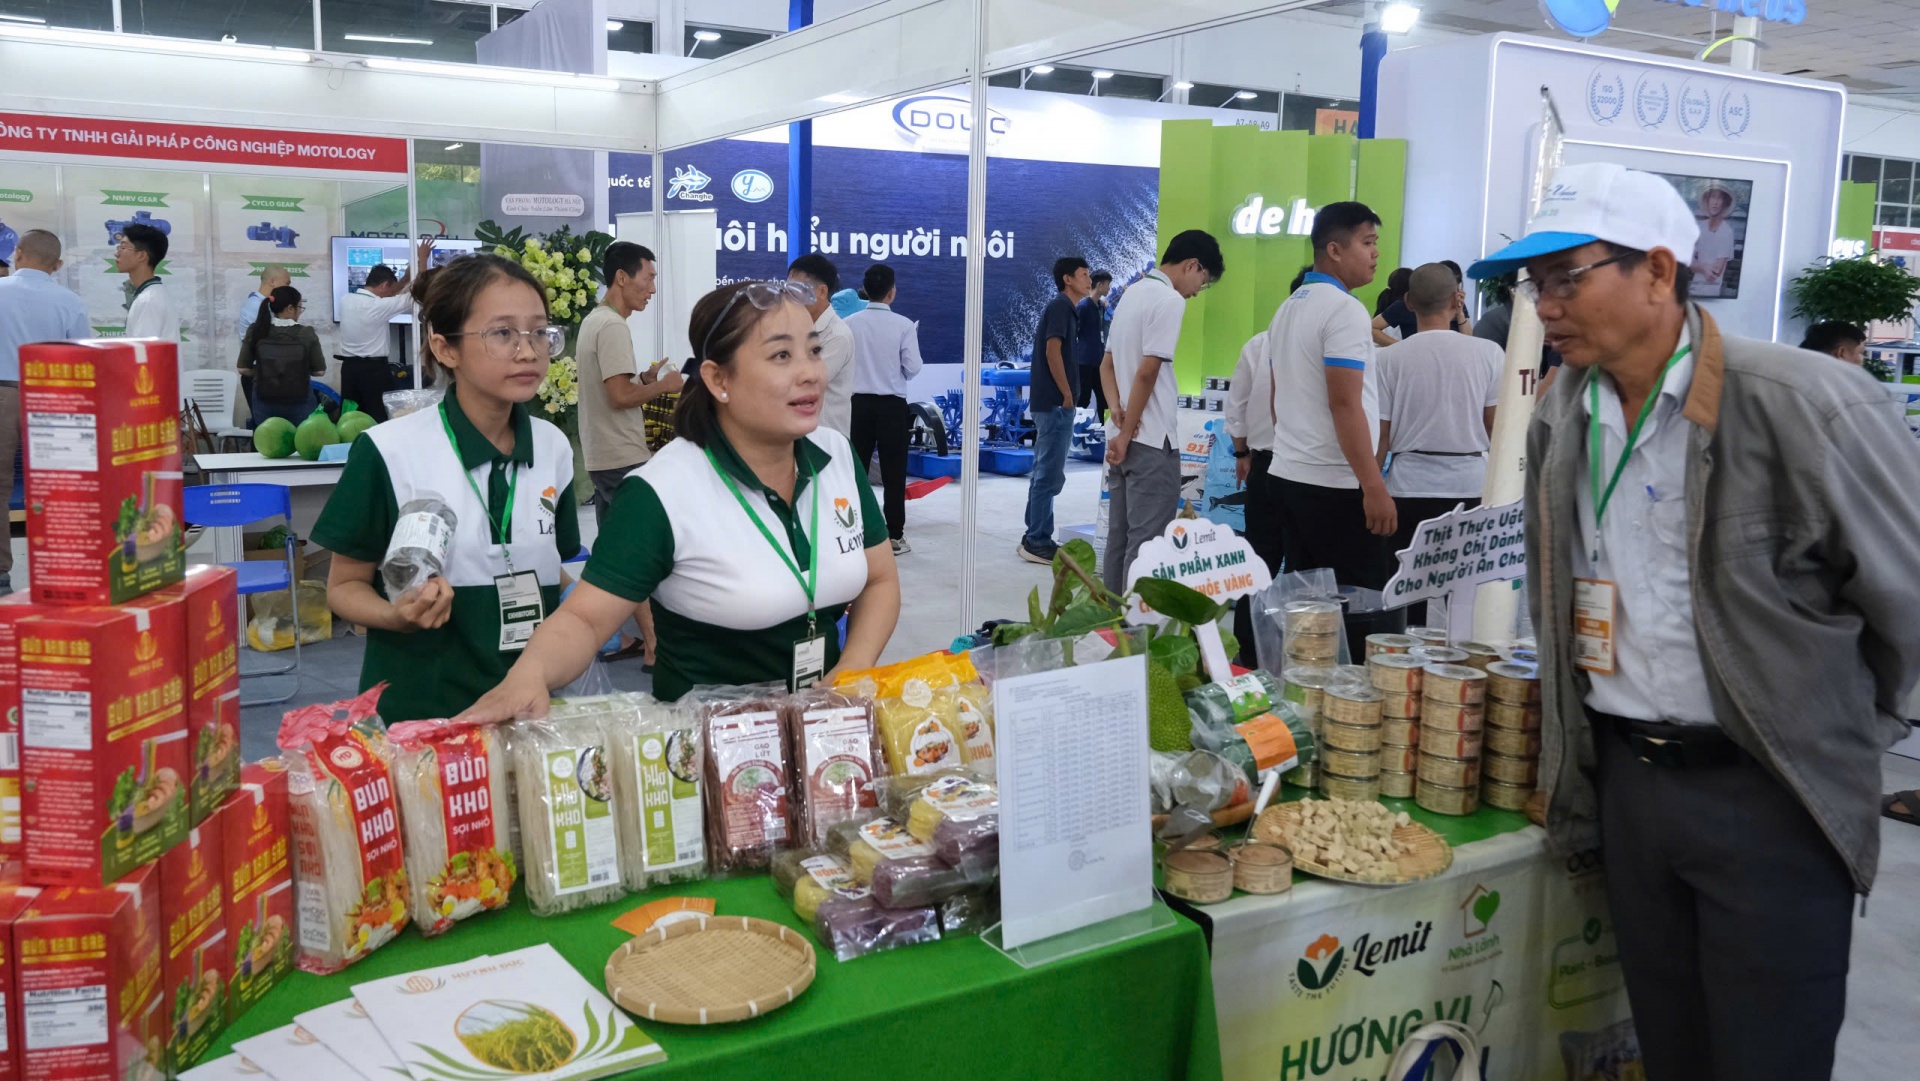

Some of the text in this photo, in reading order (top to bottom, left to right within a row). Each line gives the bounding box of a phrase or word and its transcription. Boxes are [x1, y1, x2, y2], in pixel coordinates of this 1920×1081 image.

[1728, 107, 1743, 117] ASC
[36, 127, 58, 138] TY
[62, 128, 107, 143] TNHH
[111, 129, 142, 146] GIẢI
[146, 132, 190, 149] PHÁP
[193, 135, 238, 151] CÔNG
[241, 140, 295, 158] NGHIỆP
[298, 144, 376, 160] MOTOLOGY
[608, 174, 651, 189] uốc tế
[680, 192, 713, 201] Changhe
[112, 194, 158, 203] NMRV GEAR
[251, 200, 275, 208] CYCLO
[1233, 196, 1285, 235] de
[850, 227, 940, 260] người
[950, 228, 1014, 258] nôi
[1424, 525, 1453, 546] Thịt
[1458, 517, 1495, 538] Thực
[1152, 549, 1246, 580] SẢN PHẨM XANH
[1413, 546, 1459, 570] Không
[1489, 530, 1524, 551] Dành
[1224, 573, 1254, 592] VÀNG
[1394, 552, 1526, 596] Cho Người Ăn Cha
[27, 689, 87, 699] Nutrition Facts
[445, 750, 488, 786] BÚN
[353, 775, 390, 812] BÚN
[449, 786, 490, 818] KHÔ
[361, 808, 396, 845] KHÔ
[452, 815, 491, 836] SỢI NHỎ
[366, 837, 398, 863] SỢI NHỎ
[1352, 920, 1433, 977] Lemit
[1448, 934, 1500, 961] Nhà Lành
[29, 989, 72, 997] Nutrition
[1288, 957, 1350, 1000] TASTE THE FUTURE
[1280, 1009, 1424, 1081] HƯƠNG
